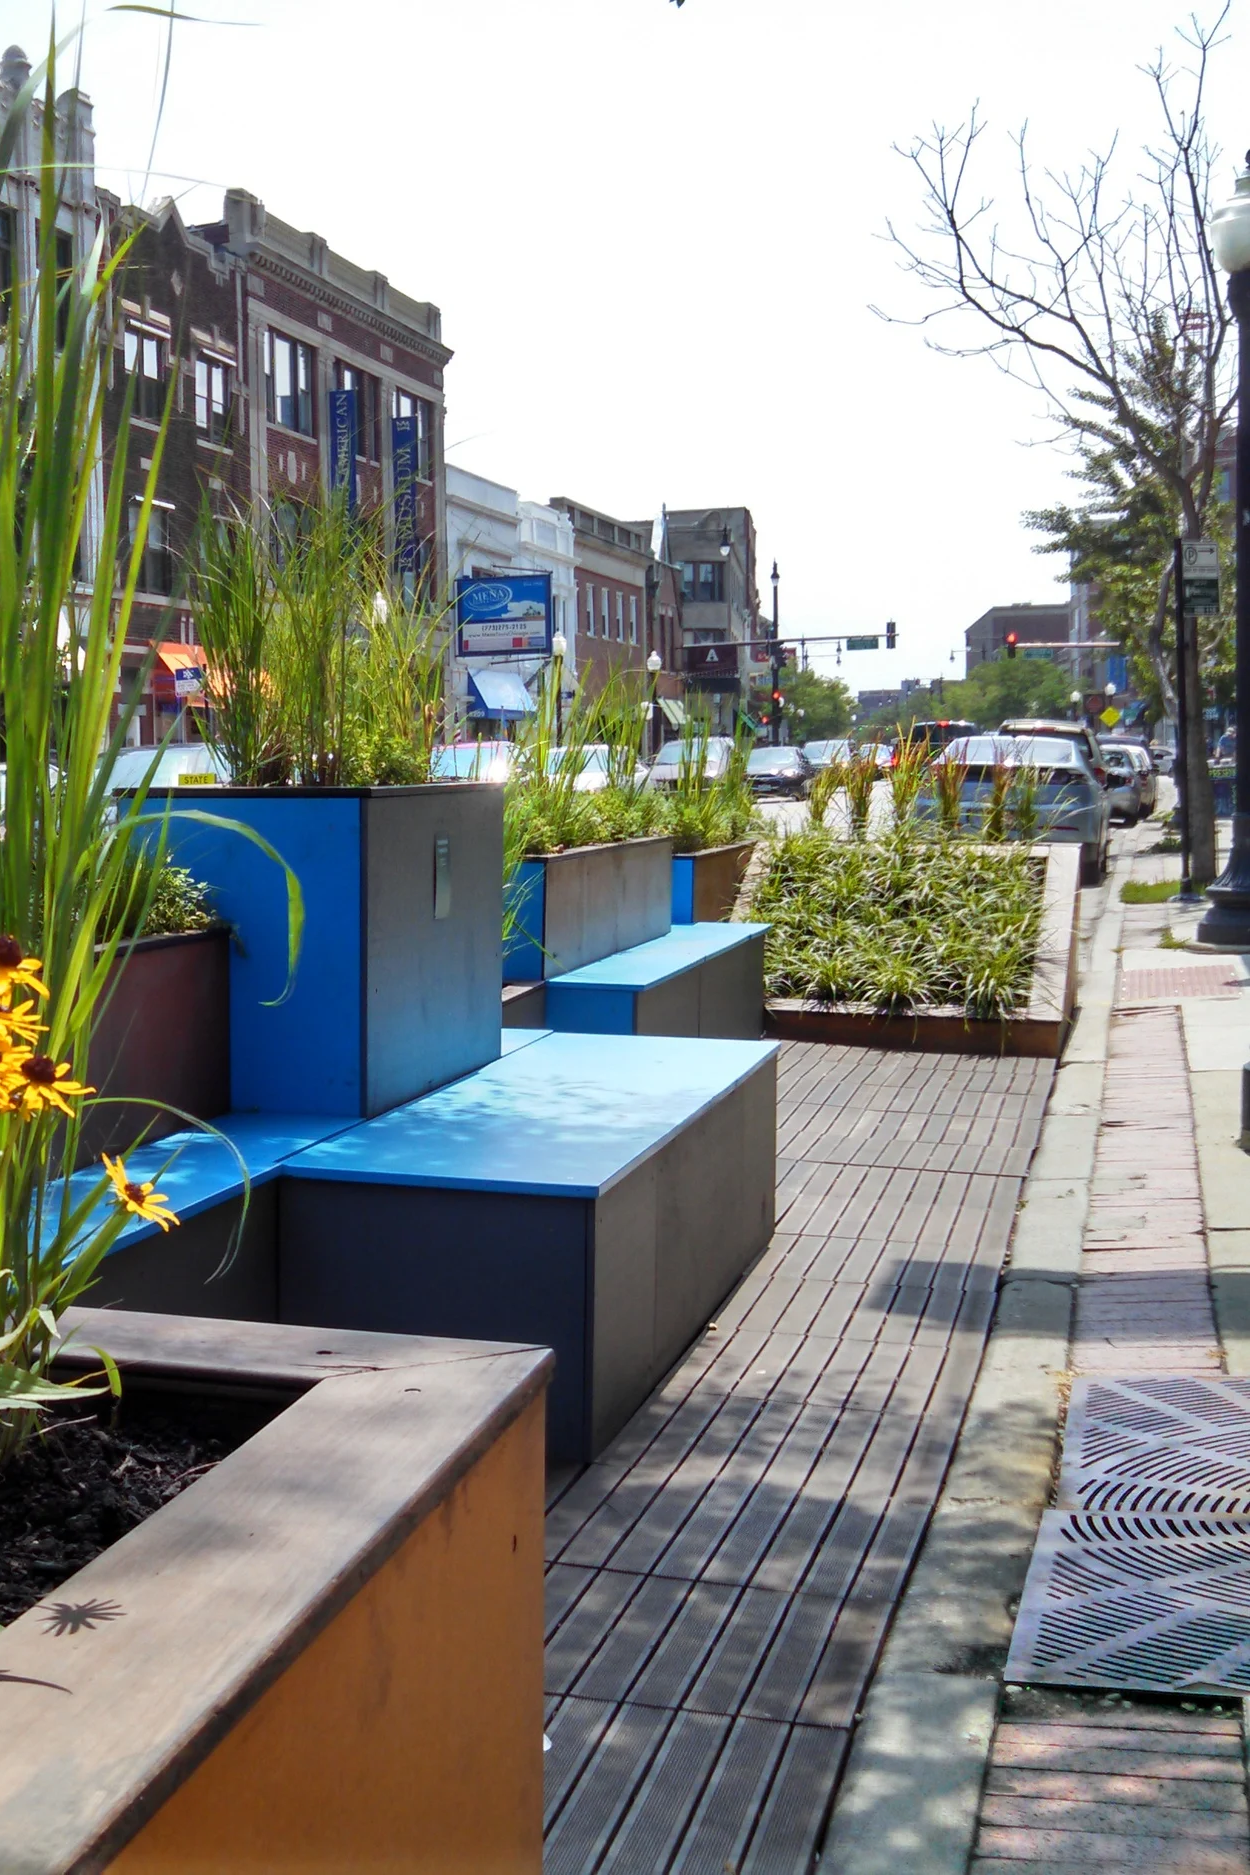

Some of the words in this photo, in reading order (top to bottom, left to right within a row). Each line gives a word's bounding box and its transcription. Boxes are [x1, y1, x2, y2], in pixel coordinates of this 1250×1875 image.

[336, 394, 350, 476] AMERICAN
[472, 588, 504, 601] MENA
[183, 775, 208, 784] STATE
